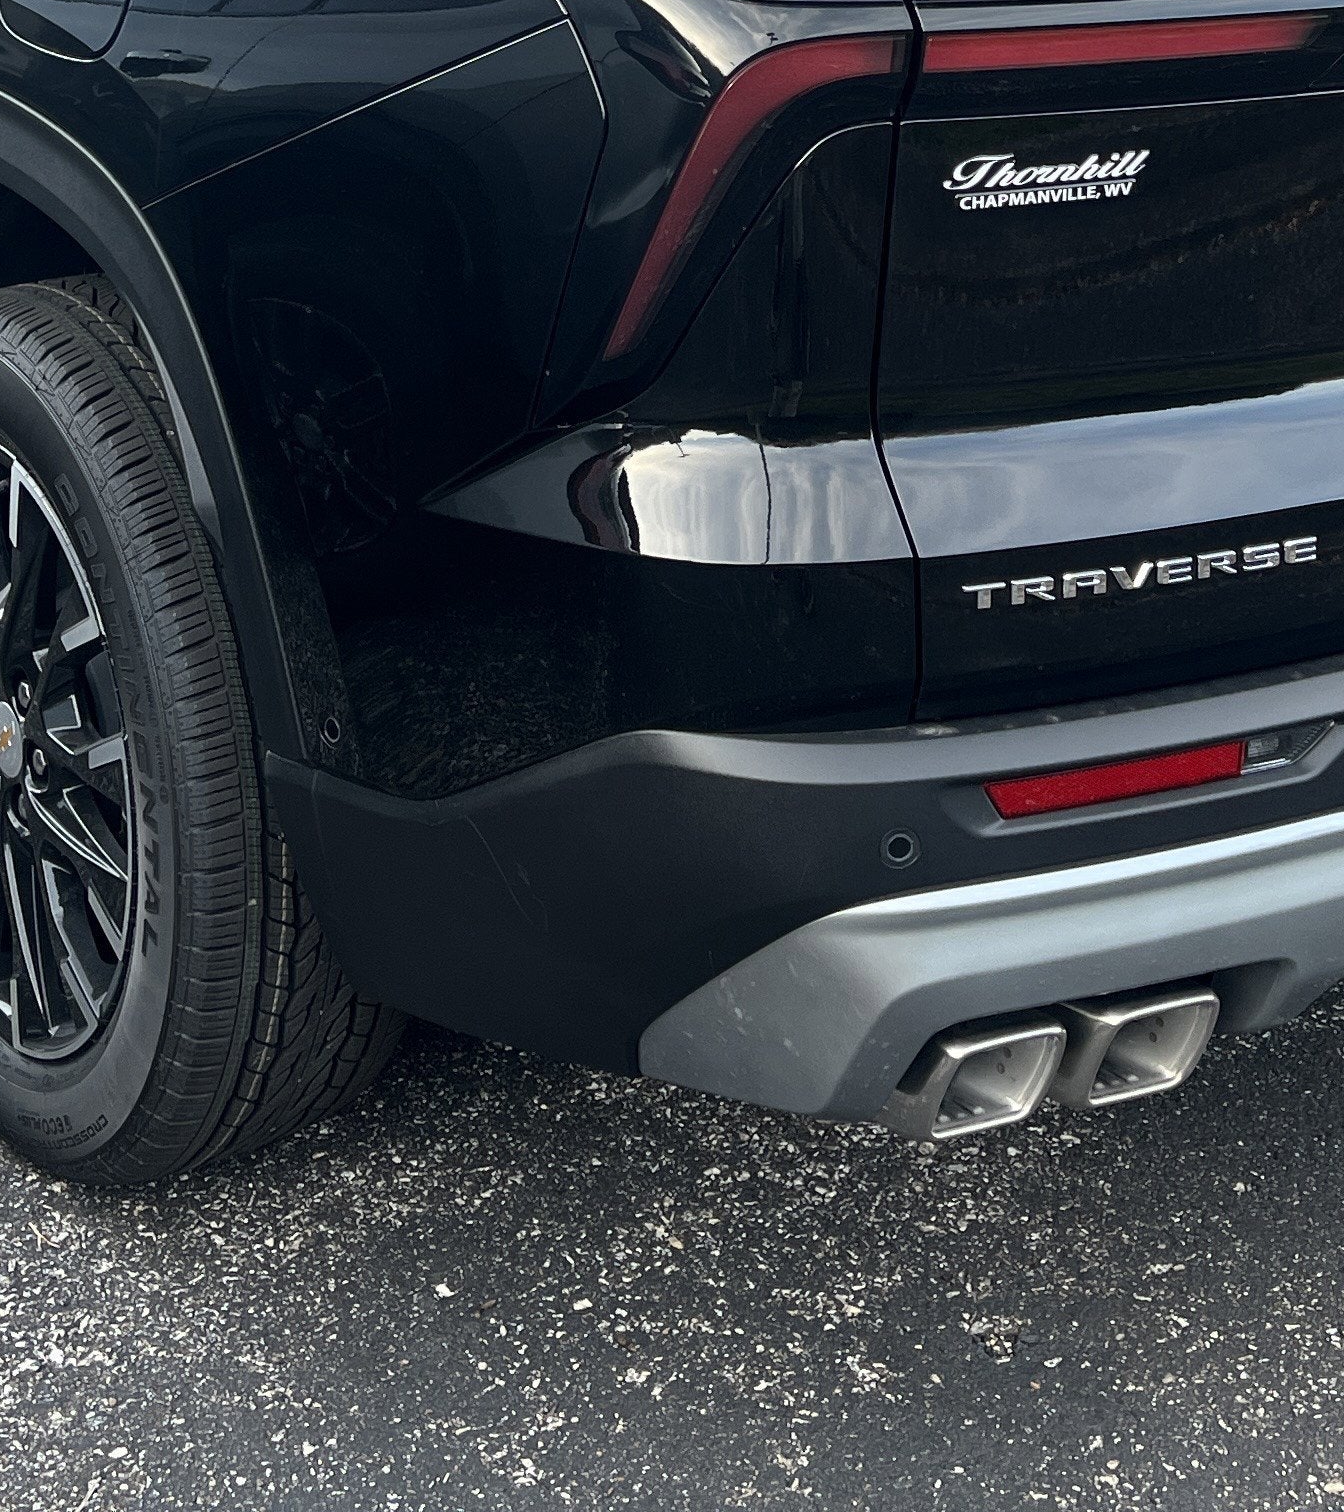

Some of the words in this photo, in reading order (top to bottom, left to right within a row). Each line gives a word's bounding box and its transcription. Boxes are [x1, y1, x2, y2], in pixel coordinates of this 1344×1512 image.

[942, 149, 1150, 190] Thornhill
[959, 184, 1101, 210] CHAPMANVILLE,
[1104, 181, 1133, 197] WV
[961, 536, 1318, 609] TRAVERSE
